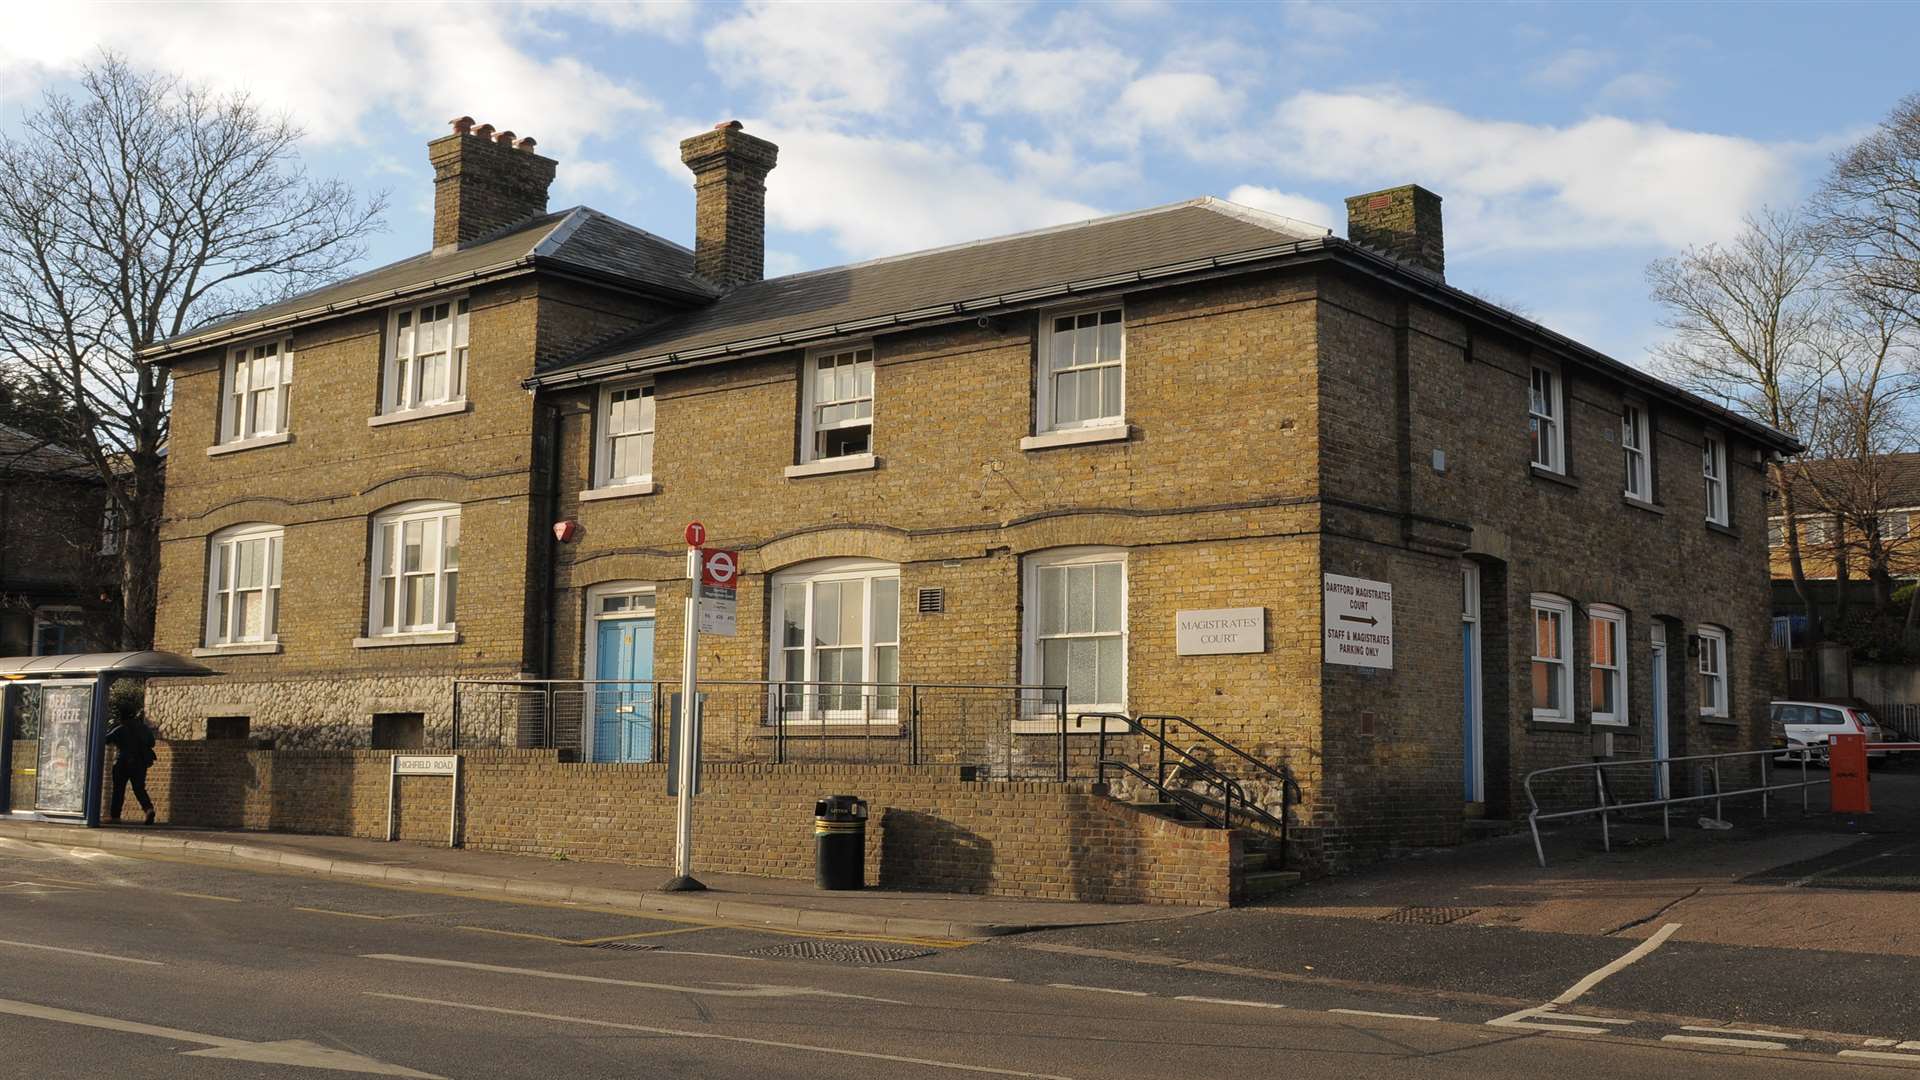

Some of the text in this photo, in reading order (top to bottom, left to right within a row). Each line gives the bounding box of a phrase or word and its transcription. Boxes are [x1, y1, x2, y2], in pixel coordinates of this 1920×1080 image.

[691, 525, 702, 542] T
[1326, 582, 1391, 601] DARTFORD MAGISTRATES
[1350, 600, 1368, 611] COURT
[1181, 617, 1260, 631] MAGISTRATES'
[1200, 633, 1239, 644] COURT
[1327, 629, 1390, 645] STAFF & MAGISTRATES
[1339, 643, 1380, 657] PARKING ONLY
[51, 708, 80, 722] FREEZE
[399, 760, 454, 770] HIGHFIELD ROAD
